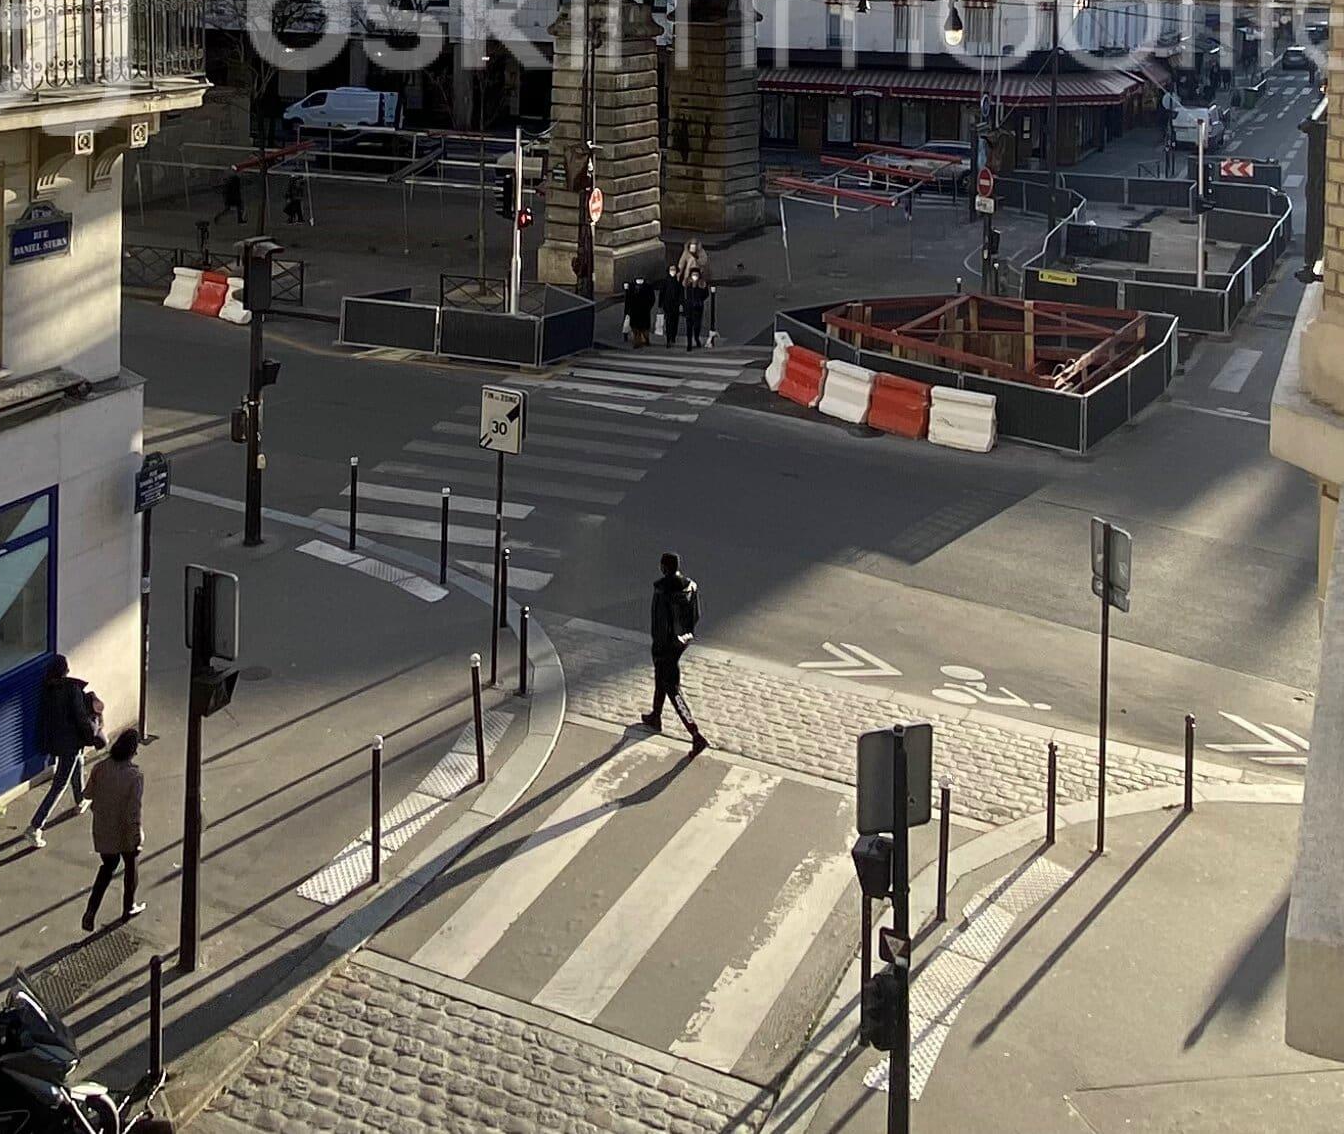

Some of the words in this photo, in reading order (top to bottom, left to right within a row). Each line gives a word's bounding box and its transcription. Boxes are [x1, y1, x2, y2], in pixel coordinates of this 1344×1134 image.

[13, 242, 41, 256] DANIEL
[43, 237, 67, 250] STERN
[491, 420, 508, 435] 30
